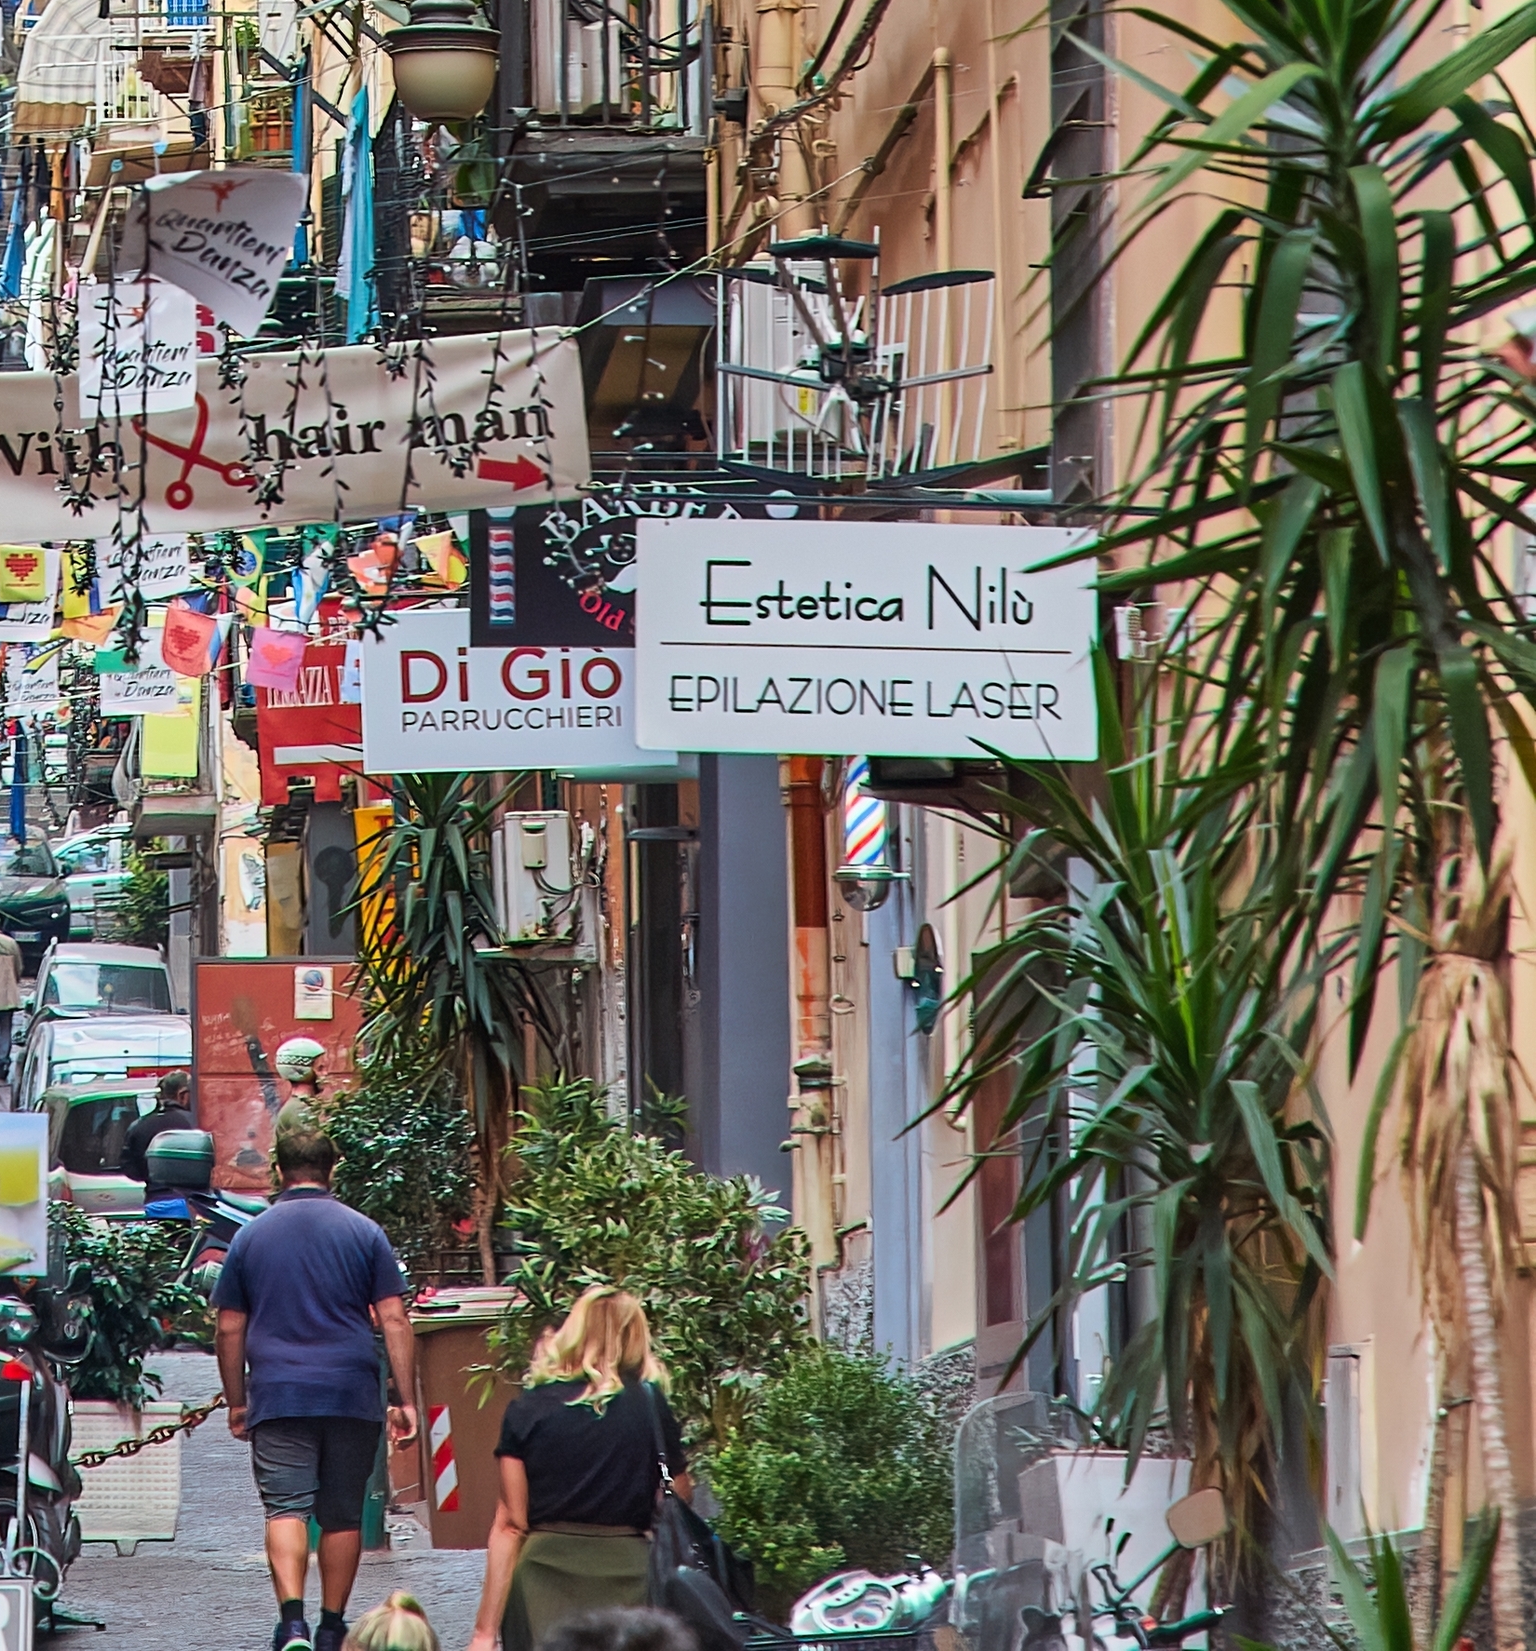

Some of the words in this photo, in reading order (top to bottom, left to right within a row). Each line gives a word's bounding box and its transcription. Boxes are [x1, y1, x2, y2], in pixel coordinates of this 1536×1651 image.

[171, 230, 271, 302] Danza
[246, 409, 386, 460] hair
[410, 404, 556, 449] man
[579, 590, 627, 631] Old
[700, 560, 903, 625] Estetica
[928, 564, 1034, 631] Nilù
[400, 647, 469, 703] Di
[501, 647, 622, 701] Giò
[669, 674, 914, 717] EPILAZIONE
[927, 681, 1062, 720] LASER
[401, 705, 622, 733] PARRUCCHIERI
